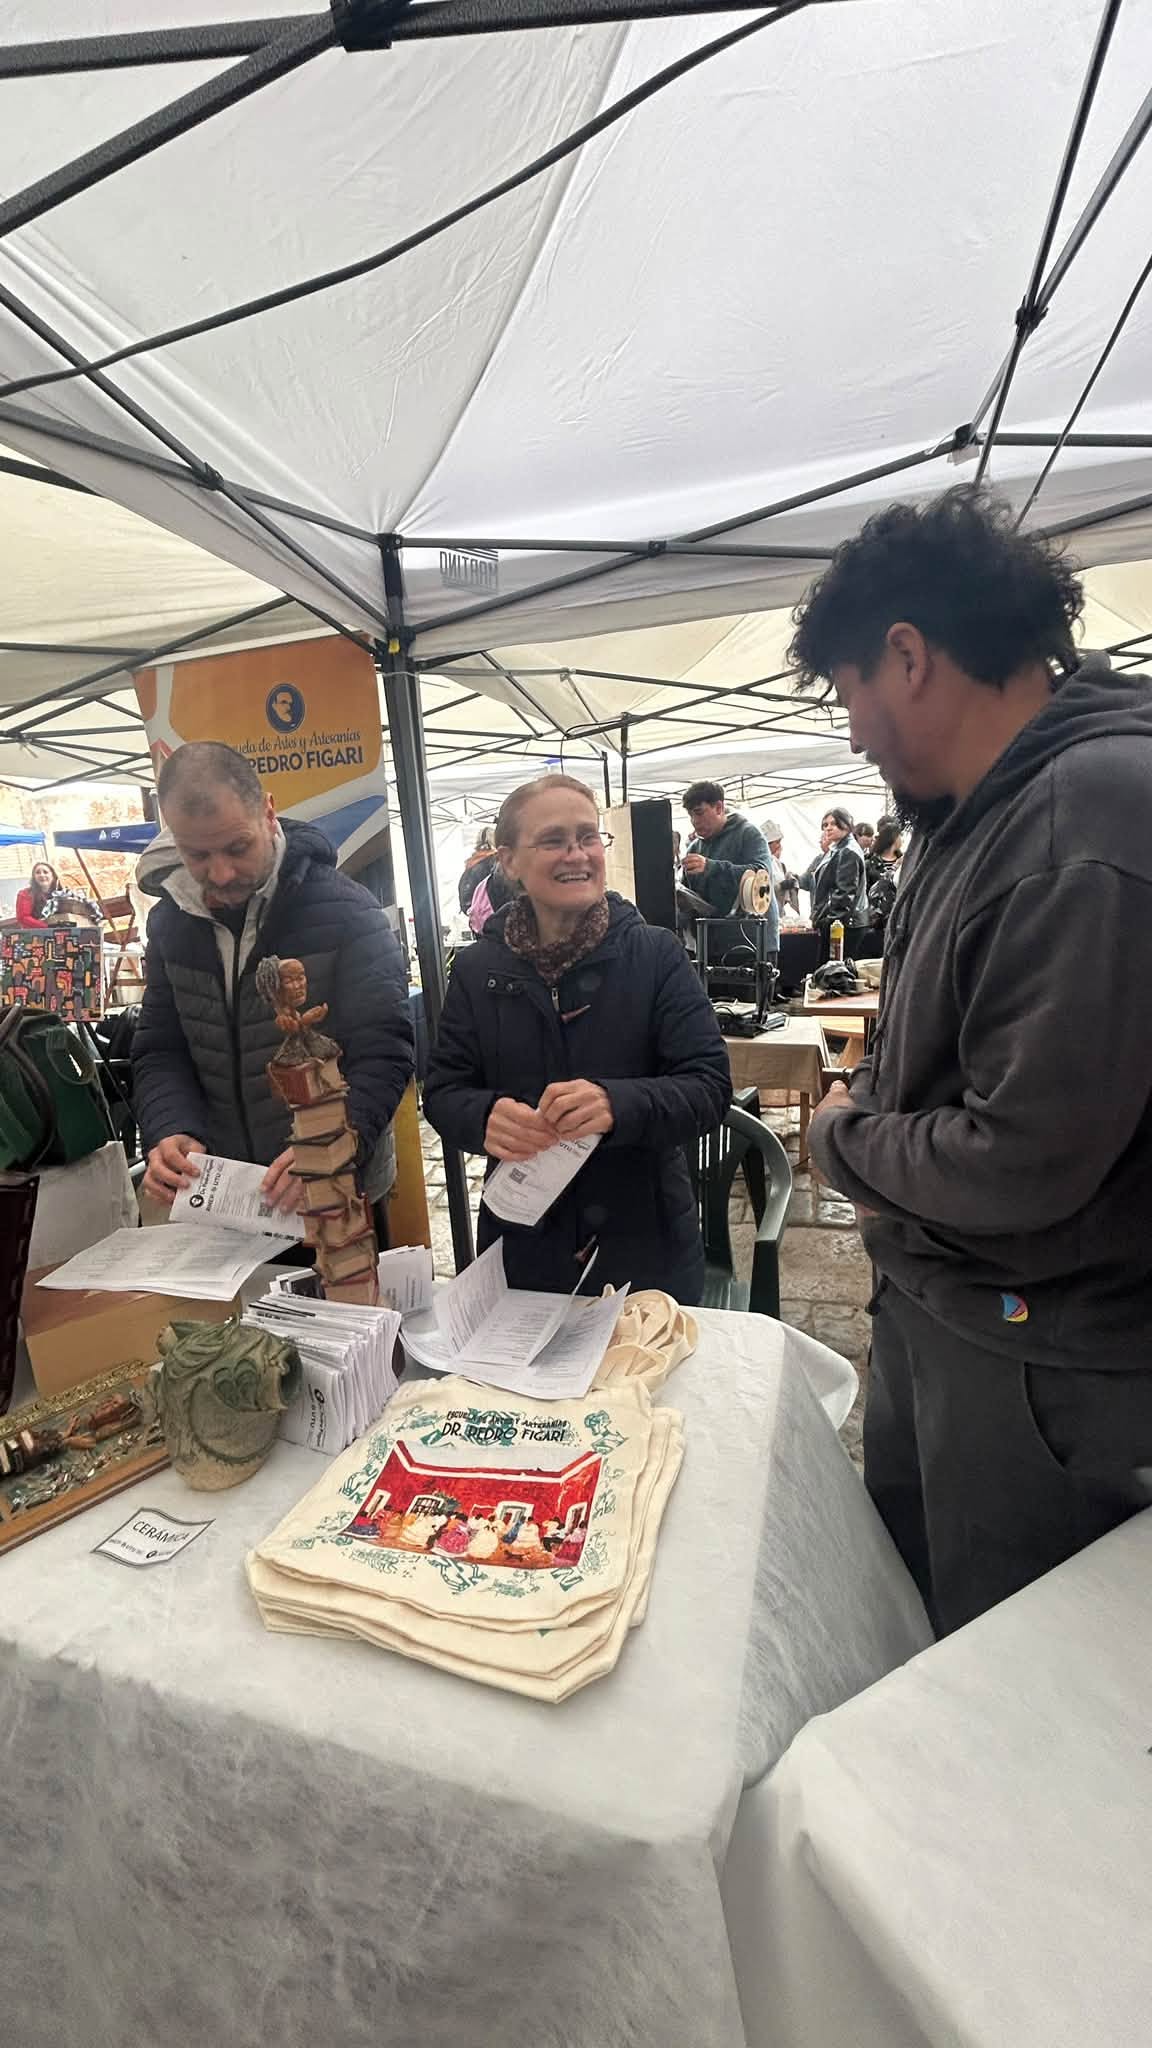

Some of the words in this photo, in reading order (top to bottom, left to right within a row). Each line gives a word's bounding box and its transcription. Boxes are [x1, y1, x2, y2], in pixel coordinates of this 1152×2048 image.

[259, 737, 272, 752] de
[274, 735, 297, 751] Artes
[248, 752, 303, 774] PEDRO
[306, 746, 363, 769] FIGARI
[442, 1422, 461, 1437] DR.
[467, 1424, 518, 1441] PEDRO
[521, 1429, 565, 1442] FIGARI
